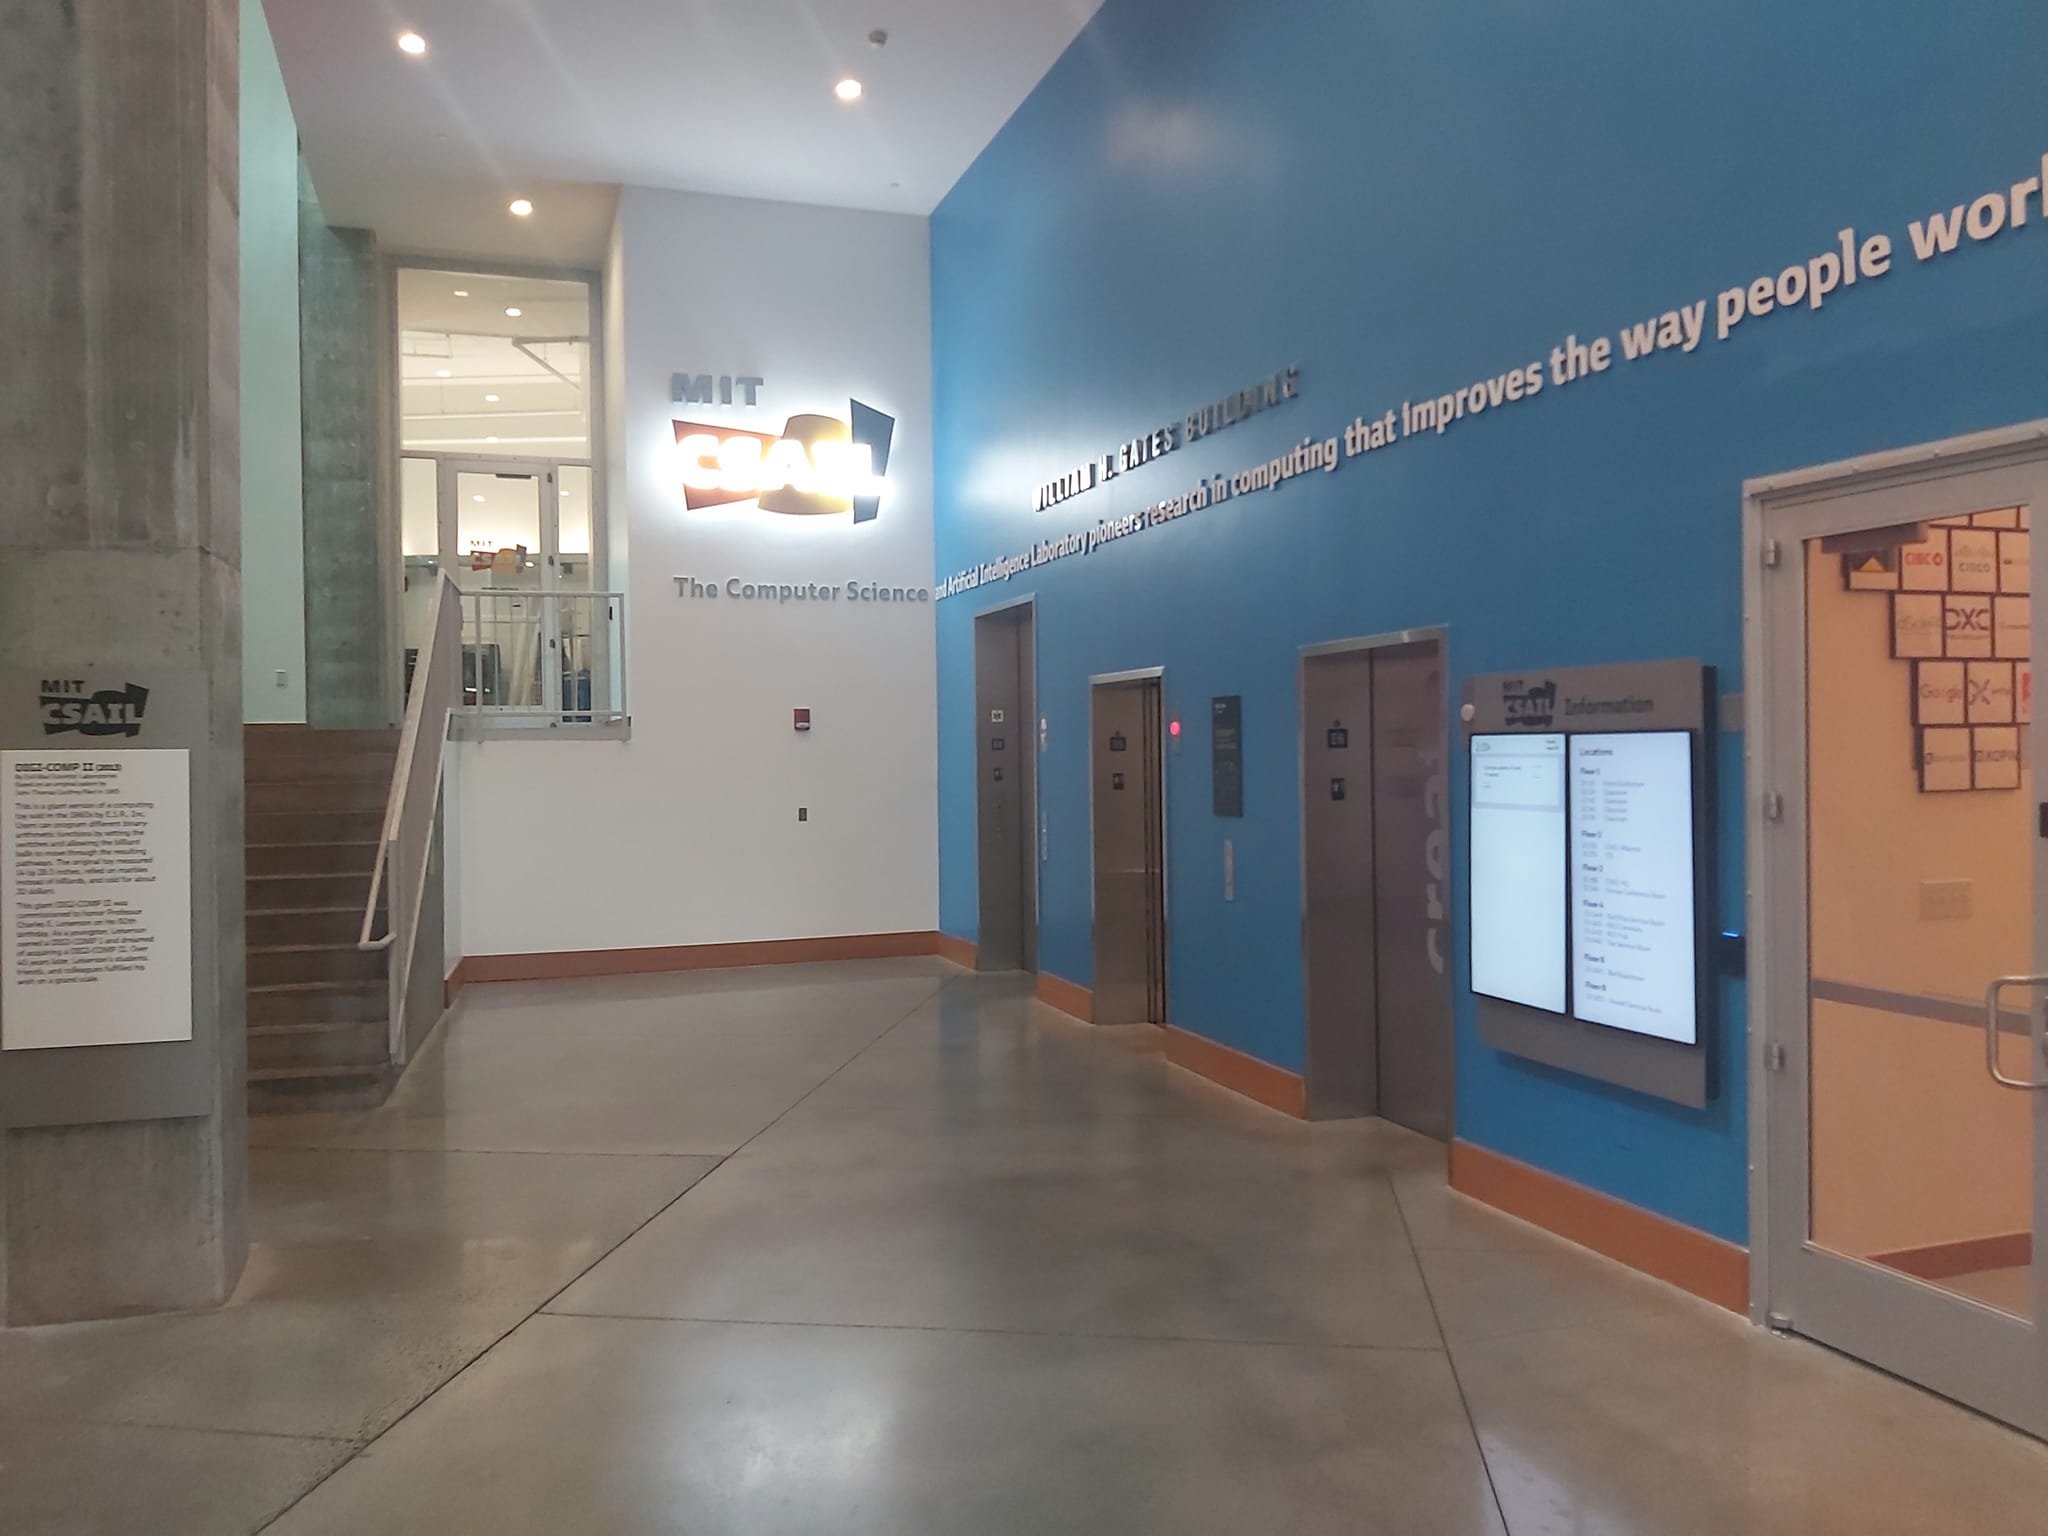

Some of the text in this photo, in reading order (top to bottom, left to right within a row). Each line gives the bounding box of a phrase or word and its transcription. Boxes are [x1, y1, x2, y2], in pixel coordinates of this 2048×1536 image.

[672, 372, 764, 407] MIT
[948, 565, 979, 596] Artificial
[980, 556, 1030, 582] Intelligence
[1031, 532, 1088, 567] Laboratory
[1089, 512, 1143, 551] pioneers
[1145, 480, 1208, 526] research
[1211, 475, 1228, 504] in
[1231, 437, 1338, 496] computing
[1344, 409, 1396, 457] that
[1549, 335, 1611, 386] the
[1620, 299, 1706, 361] way
[1717, 227, 1892, 340] people
[1032, 368, 1298, 512] WILLIAM H. GATES BUILDING
[673, 577, 929, 603] The Computer Science
[42, 680, 85, 693] MIT
[43, 703, 143, 724] CSAIL
[1566, 696, 1653, 716] Information
